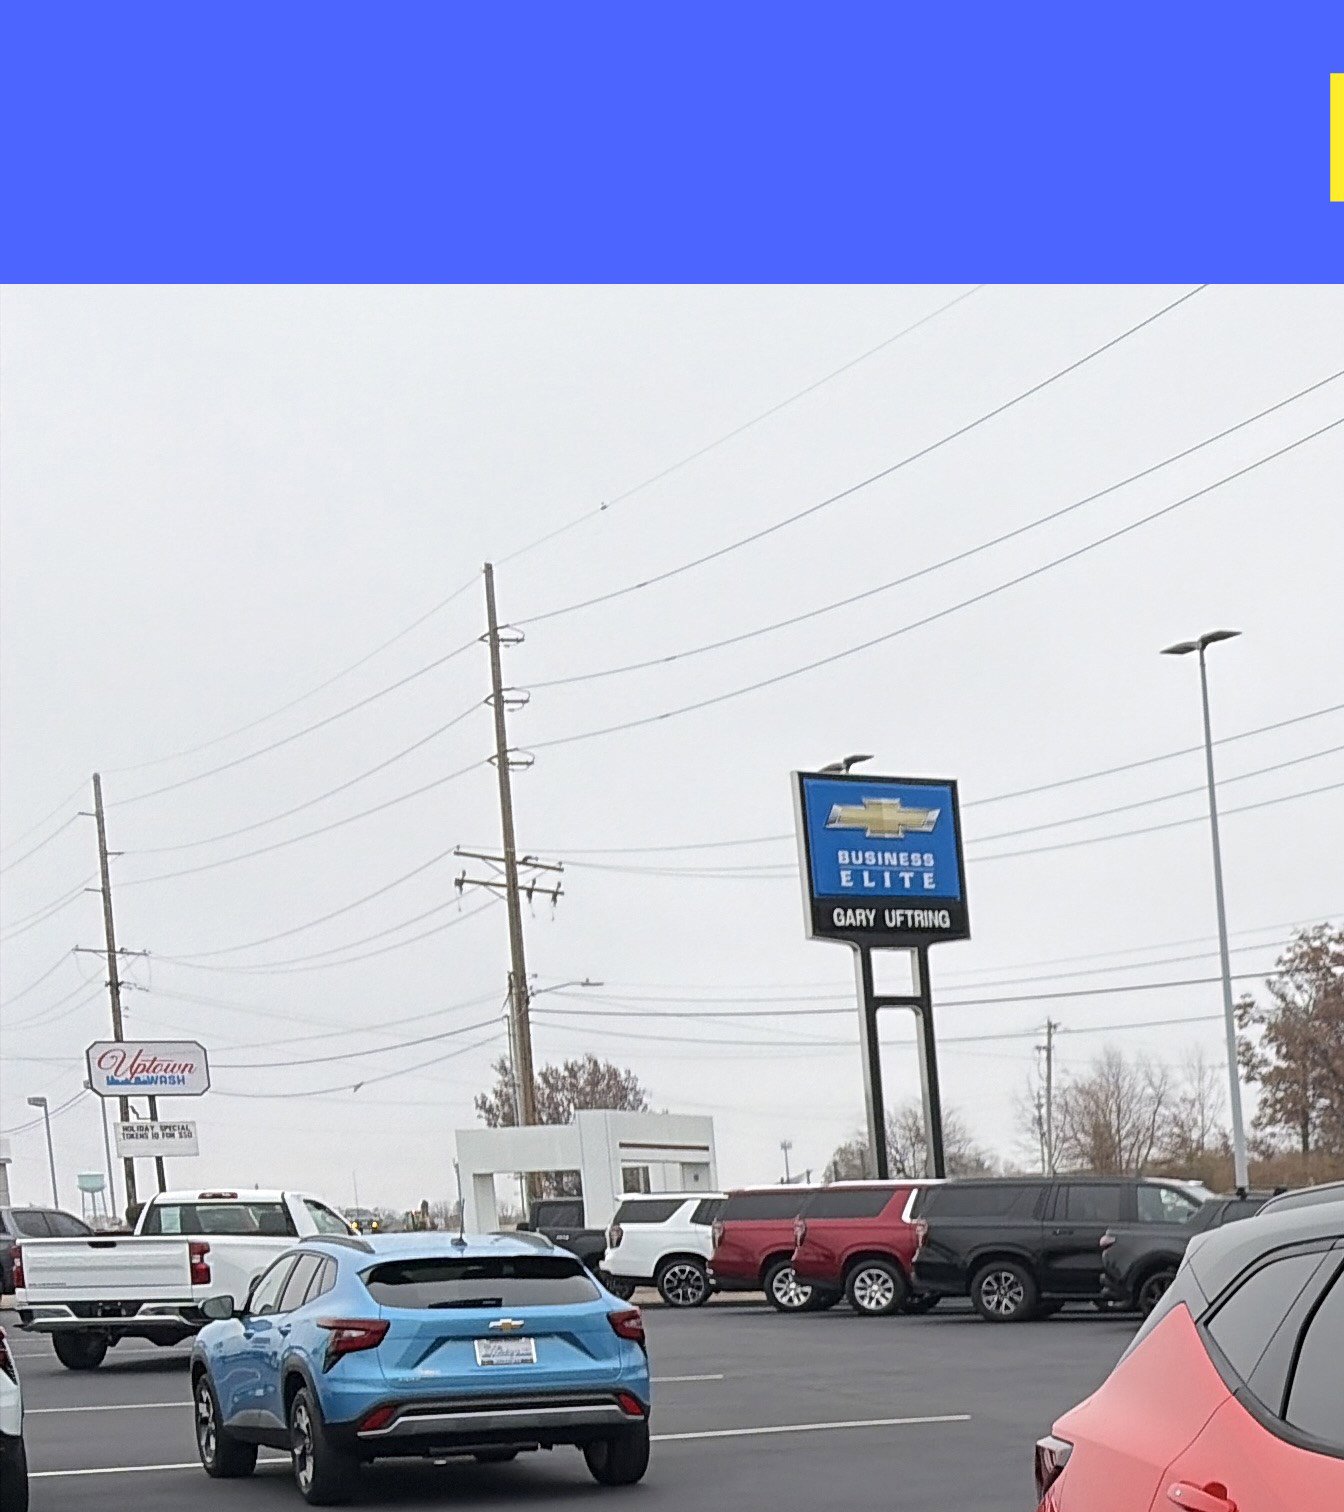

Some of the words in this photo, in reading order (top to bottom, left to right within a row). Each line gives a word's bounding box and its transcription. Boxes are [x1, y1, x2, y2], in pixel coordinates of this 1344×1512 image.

[837, 850, 935, 866] BUSINESS
[840, 870, 936, 889] ELITE
[833, 907, 876, 927] GARY
[884, 908, 951, 929] UFTRING
[97, 1048, 195, 1080] Uptown
